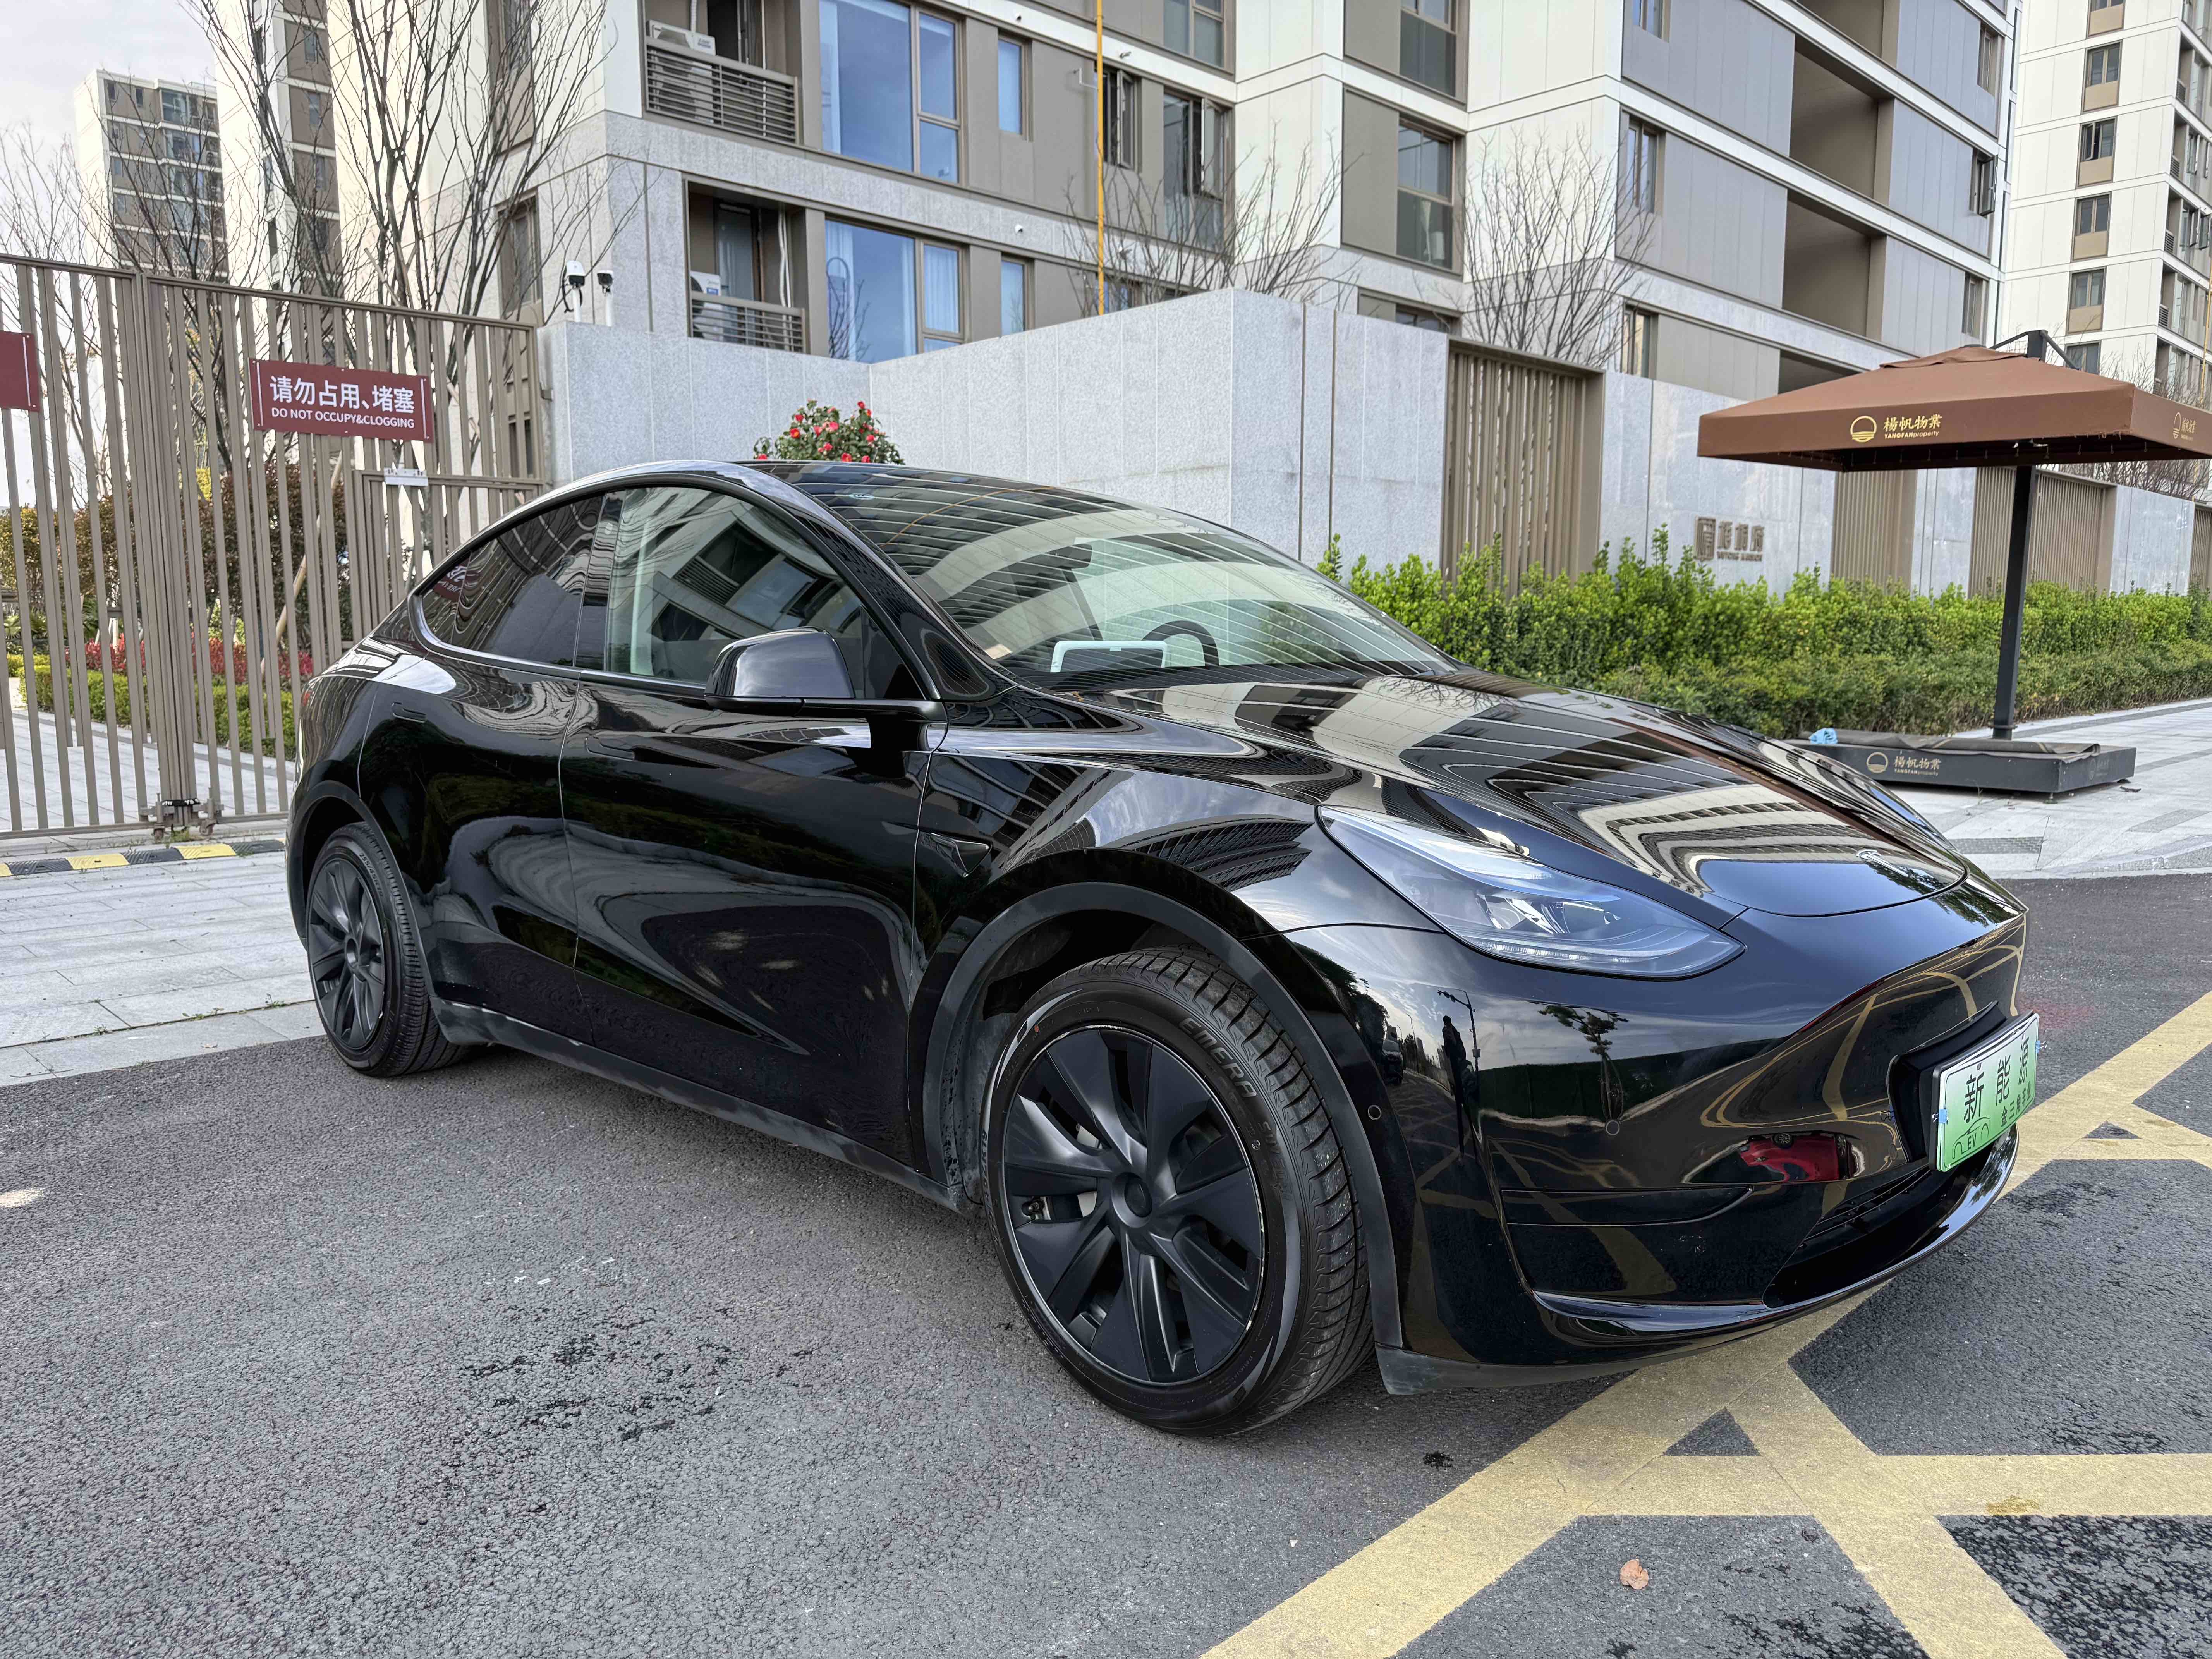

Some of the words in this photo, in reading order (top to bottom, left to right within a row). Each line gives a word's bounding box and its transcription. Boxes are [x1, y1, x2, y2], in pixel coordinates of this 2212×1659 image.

[270, 375, 415, 414] 请勿占用、堵塞
[271, 407, 287, 417] DO
[290, 410, 313, 420] NOT
[315, 411, 415, 428] OCCUPY&CLOGGING
[1179, 1017, 1258, 1098] EMERA
[1964, 1036, 2029, 1123] 新能源
[1967, 1132, 1977, 1150] EV
